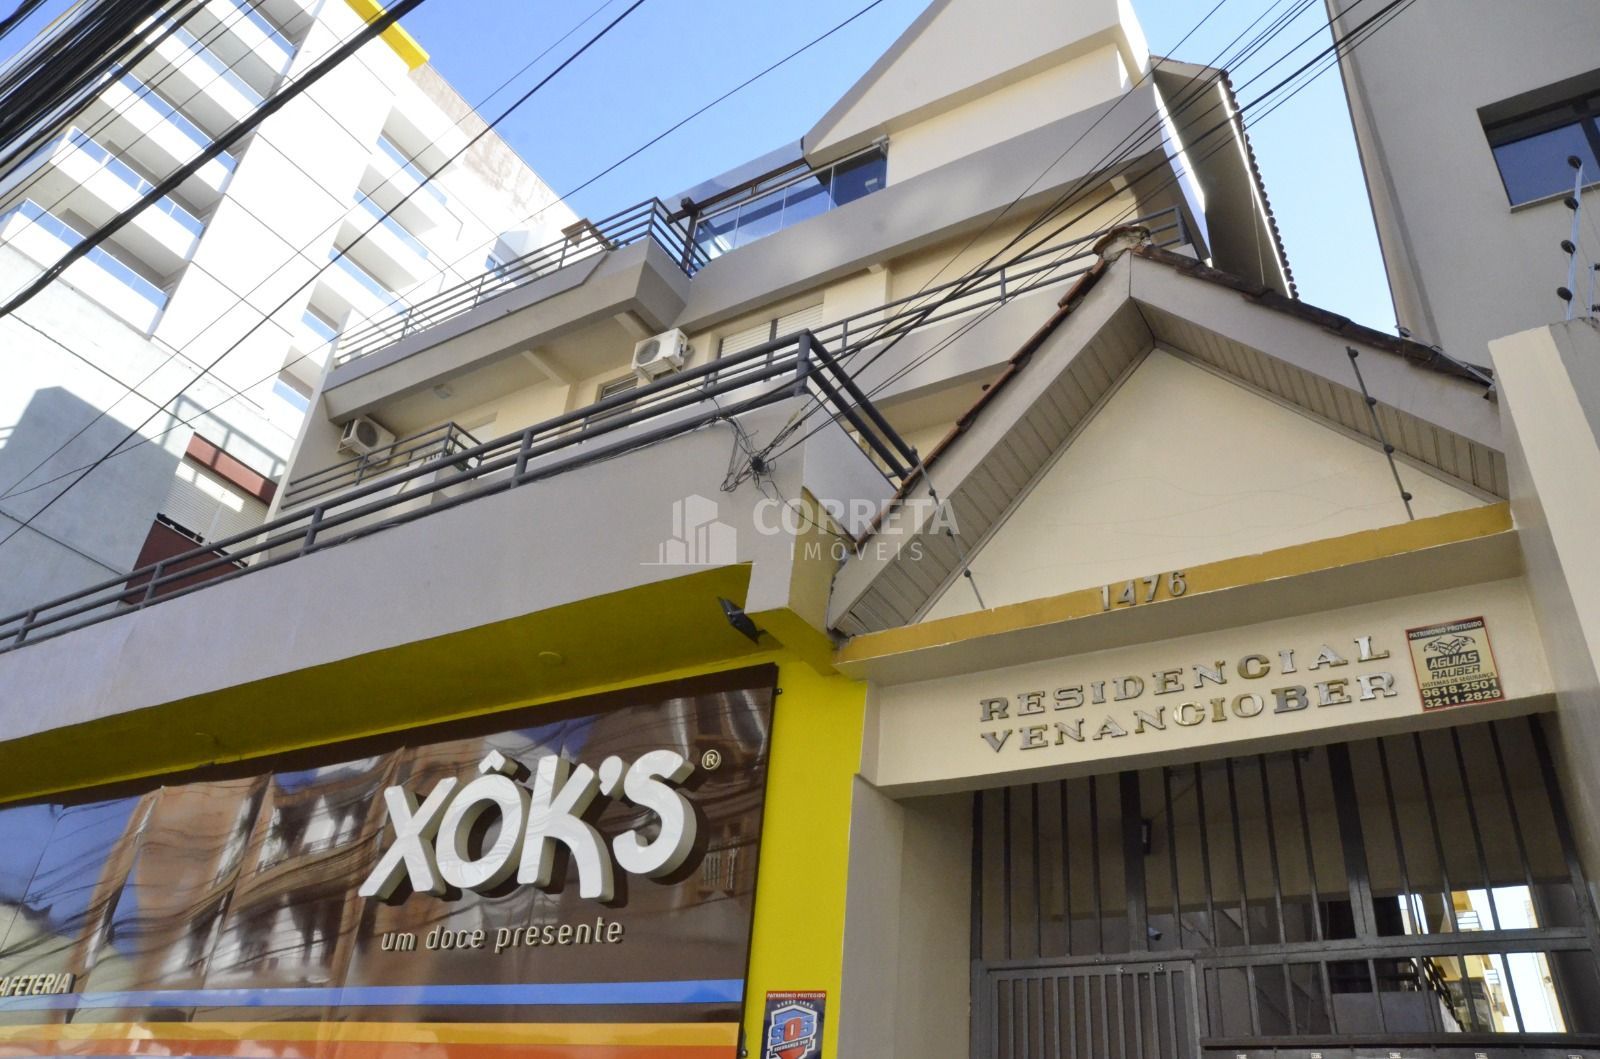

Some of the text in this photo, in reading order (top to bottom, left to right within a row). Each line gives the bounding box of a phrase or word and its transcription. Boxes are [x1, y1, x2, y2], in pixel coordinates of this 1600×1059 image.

[1100, 570, 1188, 611] 1476
[1447, 620, 1483, 634] PROTEGIDO
[1429, 651, 1478, 670] AGUIAS
[1432, 664, 1480, 680] RAUBER
[979, 635, 1390, 722] RESIDENCIAL
[1422, 679, 1498, 698] 9618.2501
[1424, 688, 1501, 708] 3211.2829
[980, 671, 1398, 753] VENANCIOBER
[358, 749, 698, 901] XÔK'S
[381, 917, 624, 954] um doce presente
[0, 973, 73, 997] AFETERIA
